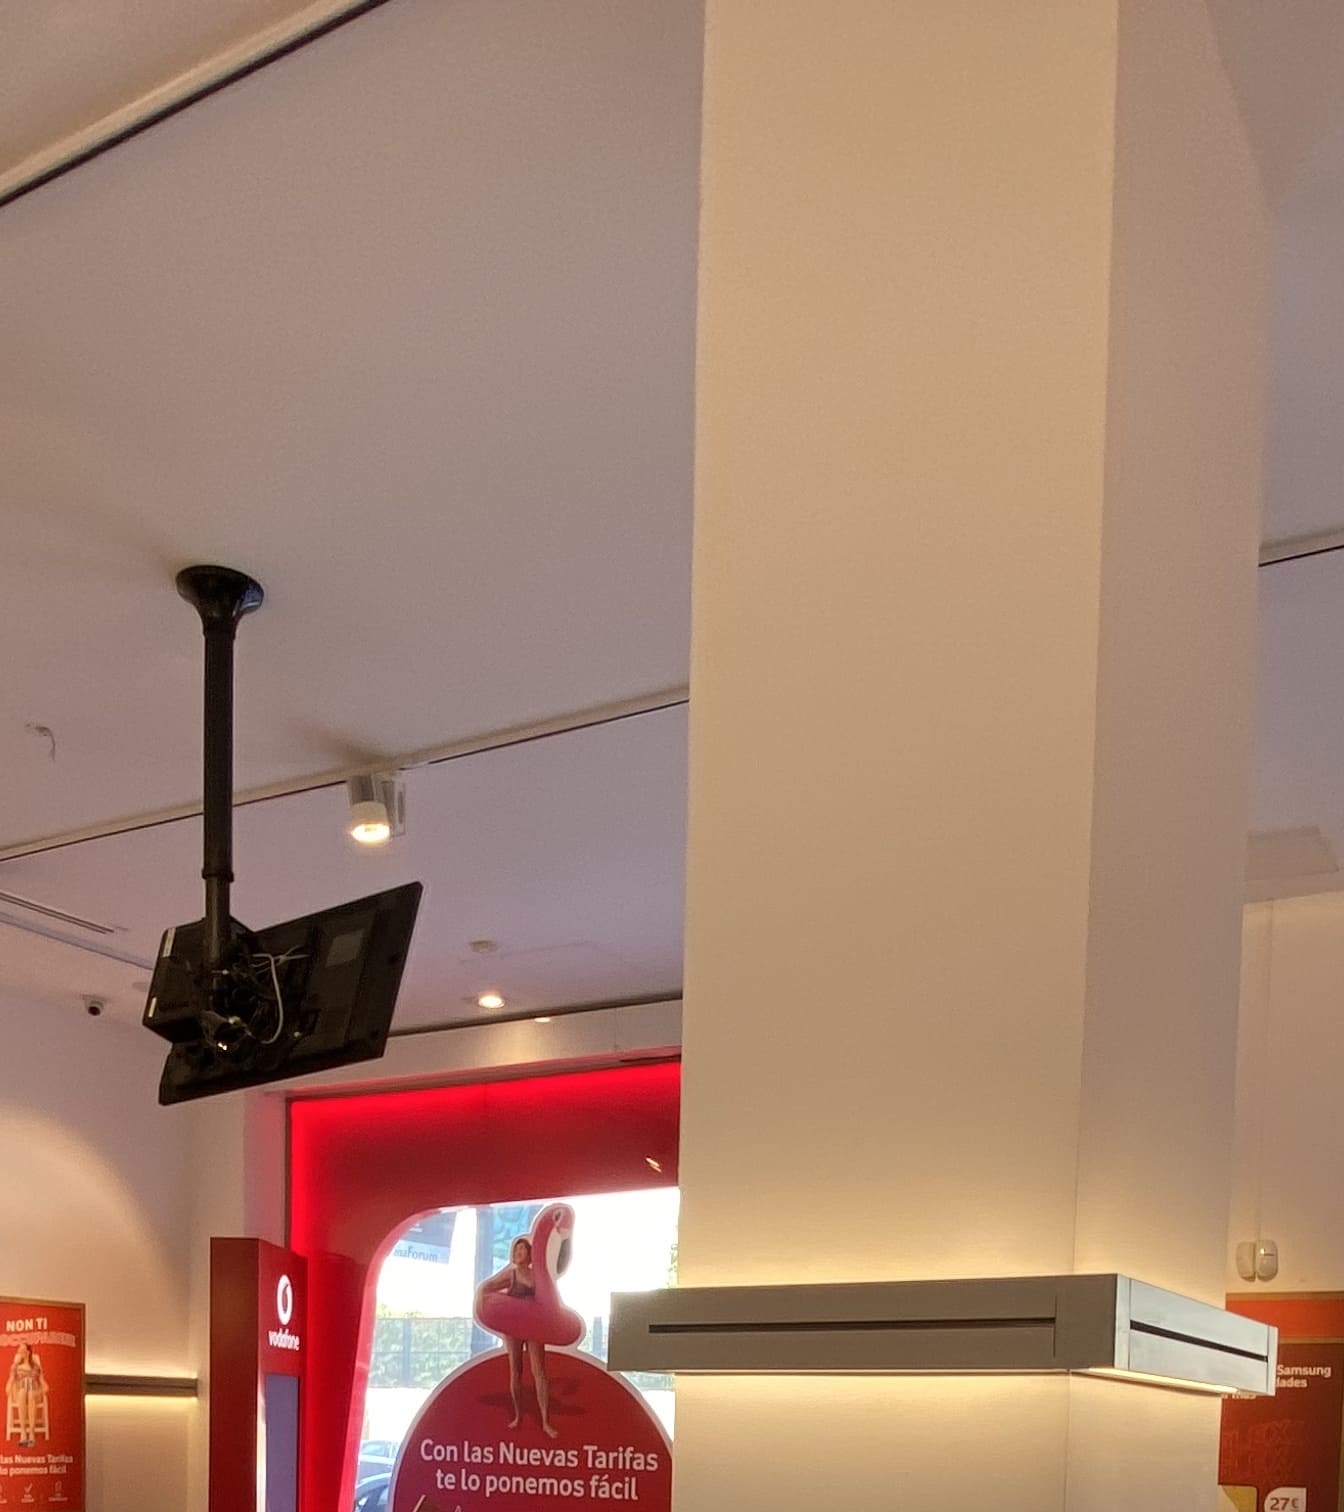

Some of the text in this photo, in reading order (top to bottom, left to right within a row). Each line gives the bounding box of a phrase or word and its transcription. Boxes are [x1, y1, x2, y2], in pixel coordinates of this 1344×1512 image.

[6, 1317, 47, 1332] NON TI
[268, 1327, 300, 1351] vodafone
[1277, 1364, 1332, 1378] Samsung
[0, 1454, 13, 1464] las
[14, 1454, 46, 1464] Nuevas
[420, 1438, 659, 1471] Con las Nuevas Tarifas
[436, 1468, 639, 1500] te lo ponemos fácil
